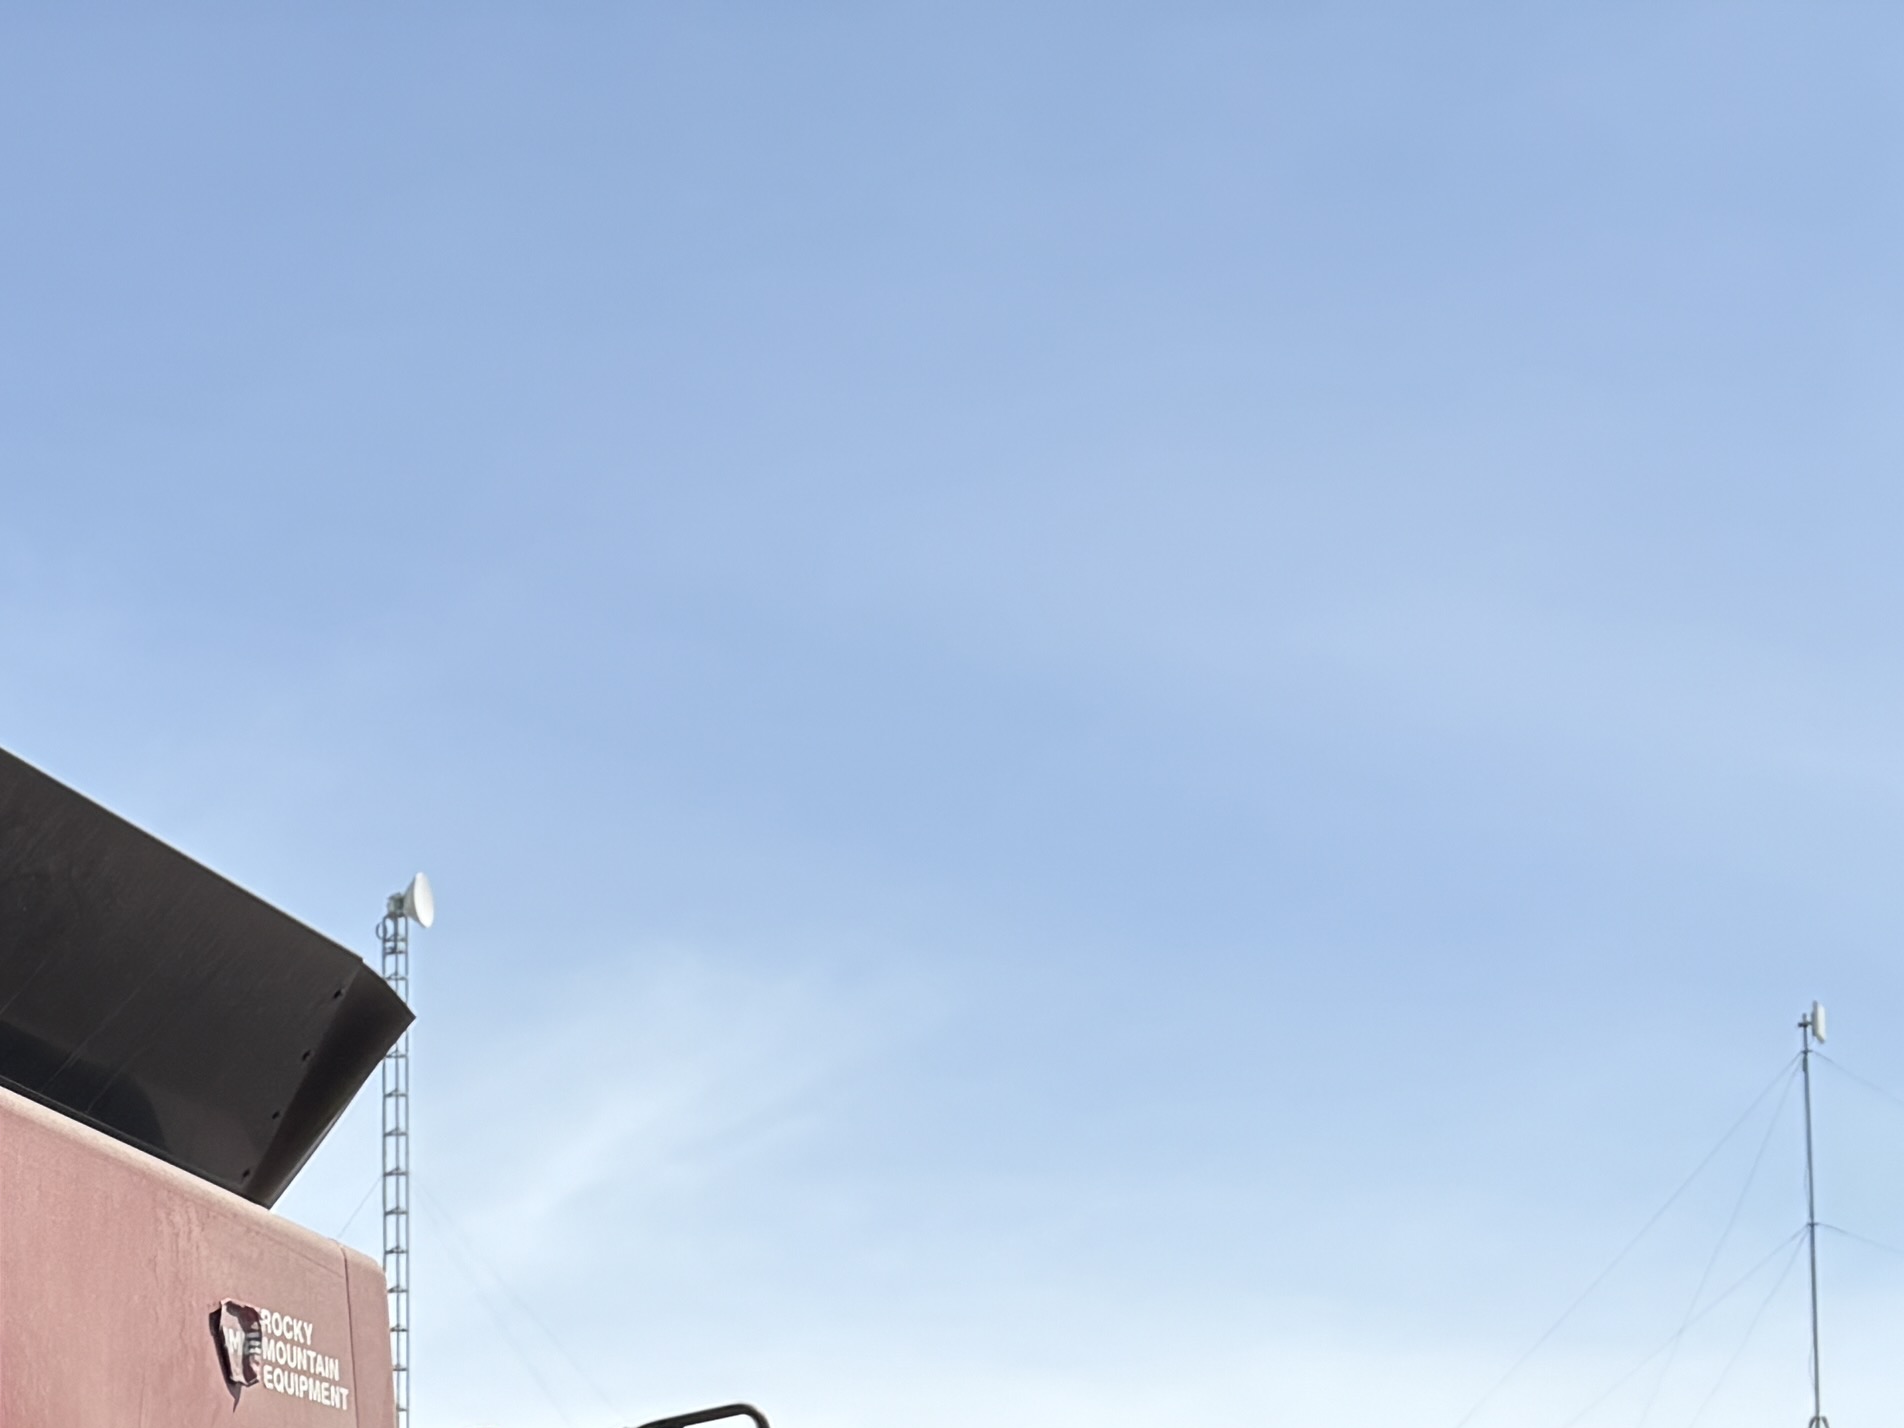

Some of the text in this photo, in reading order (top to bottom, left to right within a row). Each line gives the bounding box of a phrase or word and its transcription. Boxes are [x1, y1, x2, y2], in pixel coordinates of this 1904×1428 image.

[259, 1308, 313, 1346] ROCKY
[262, 1337, 340, 1381] MOUNTAIN
[263, 1365, 349, 1410] EQUIPMENT
